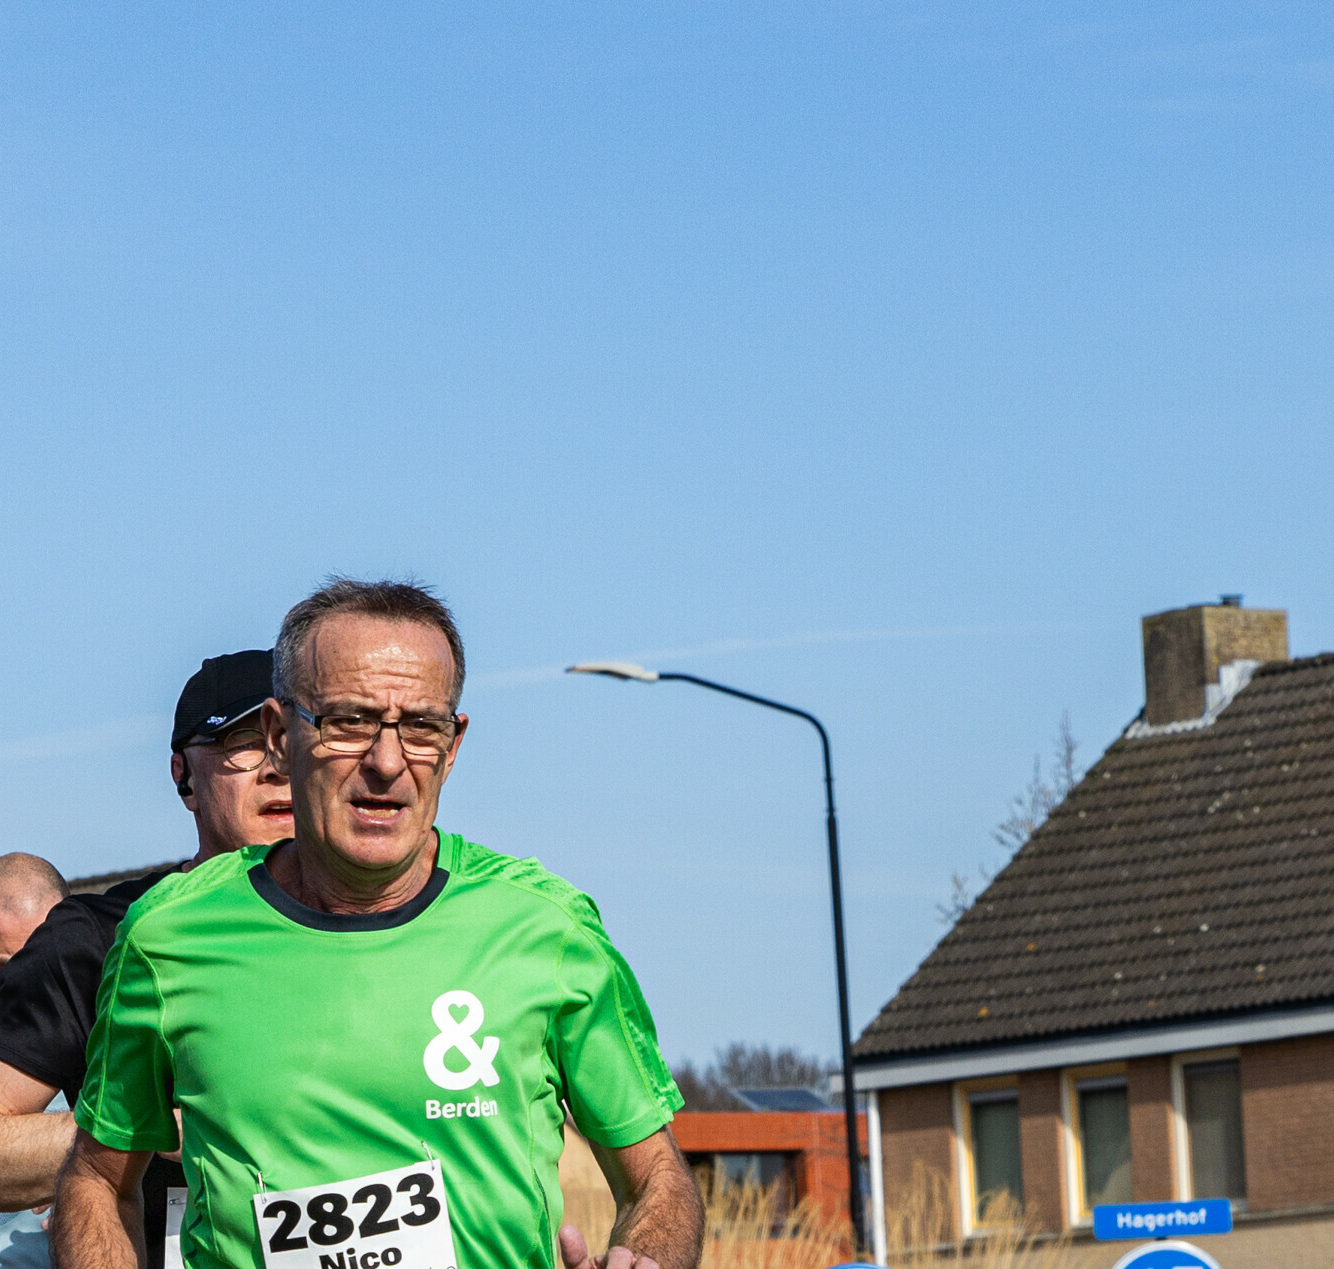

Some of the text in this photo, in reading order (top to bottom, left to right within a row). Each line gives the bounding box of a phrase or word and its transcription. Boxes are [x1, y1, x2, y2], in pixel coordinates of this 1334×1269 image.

[423, 990, 500, 1090] &
[425, 1096, 498, 1119] Berden
[262, 1173, 441, 1254] 2823
[1116, 1207, 1207, 1233] Hagerhof
